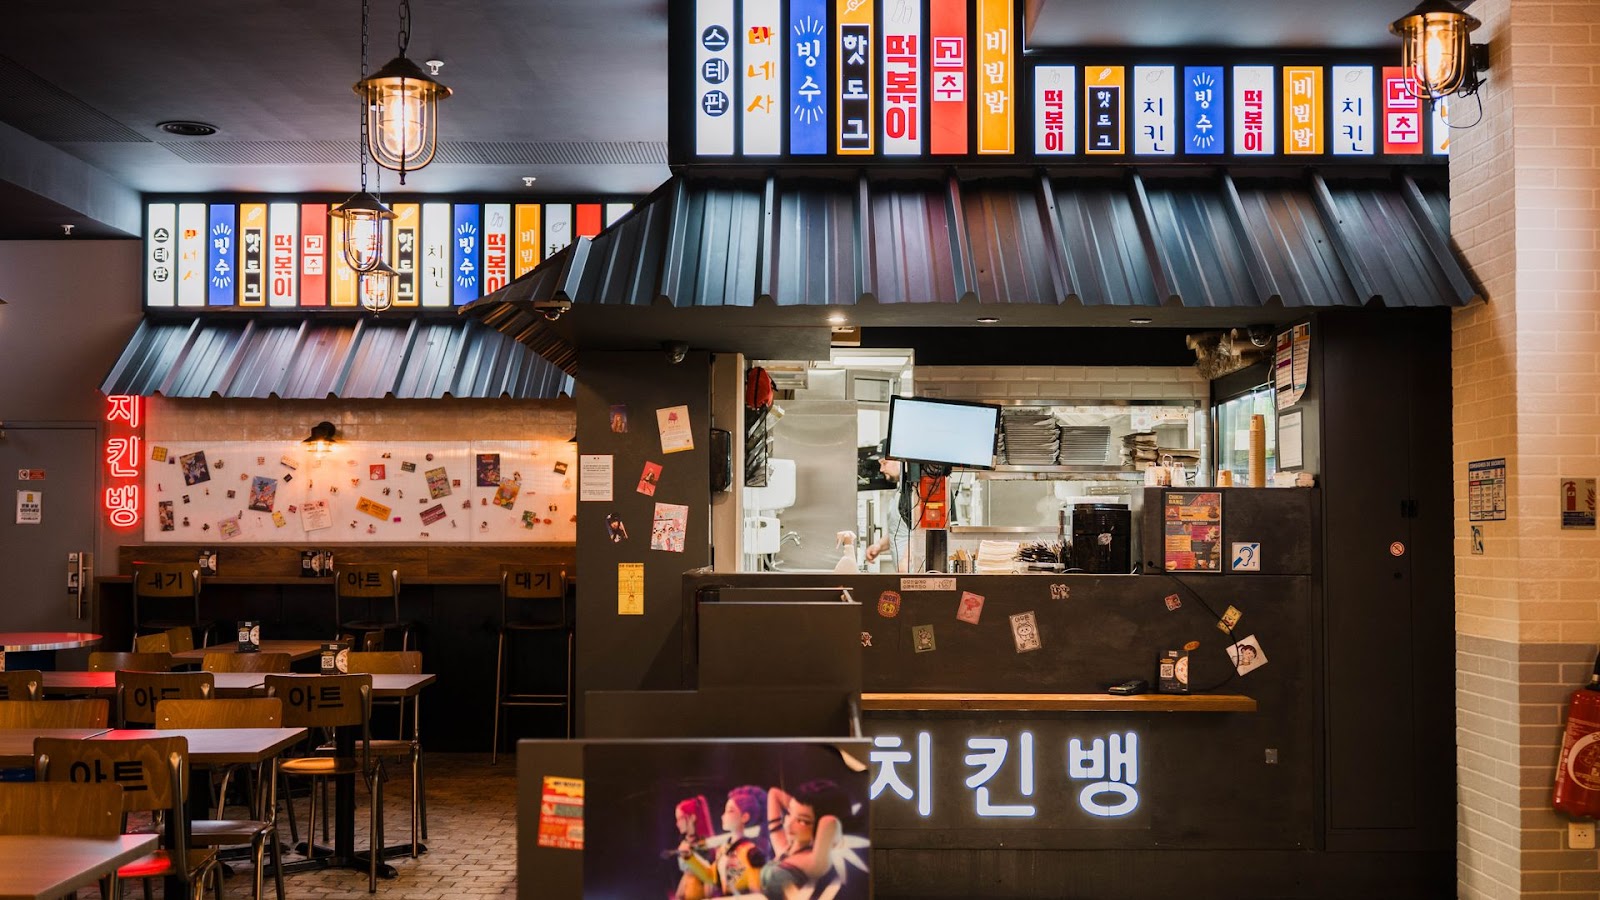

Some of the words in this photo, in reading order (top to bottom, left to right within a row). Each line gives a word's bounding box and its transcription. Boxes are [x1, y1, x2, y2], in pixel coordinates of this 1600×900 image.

[702, 25, 729, 117] 스테판
[797, 41, 821, 103] 빙수
[843, 34, 868, 139] 핫도그
[886, 35, 917, 140] 떡볶이
[935, 38, 963, 100] 고추
[984, 29, 1008, 114] 비빔밥
[1044, 90, 1063, 151] 떡볶이
[1097, 91, 1111, 146] 핫도그
[1143, 98, 1164, 151] 치킨
[1196, 90, 1213, 134] 빙수
[1244, 90, 1262, 151] 떡볶이
[1293, 78, 1313, 148] 비빔밥
[1342, 98, 1362, 151] 치킨
[214, 237, 230, 275] 빙수
[245, 233, 260, 297] 핫도그
[274, 235, 292, 296] 떡볶이
[304, 235, 323, 274] 고추
[398, 233, 414, 297] 핫도그
[428, 244, 443, 287] 치킨
[459, 236, 475, 274] 빙수
[348, 572, 381, 589] 아트
[515, 572, 551, 590] 대기
[289, 685, 344, 712] 아트
[70, 760, 148, 791] 아트
[870, 731, 1139, 817] 치킨뱅
